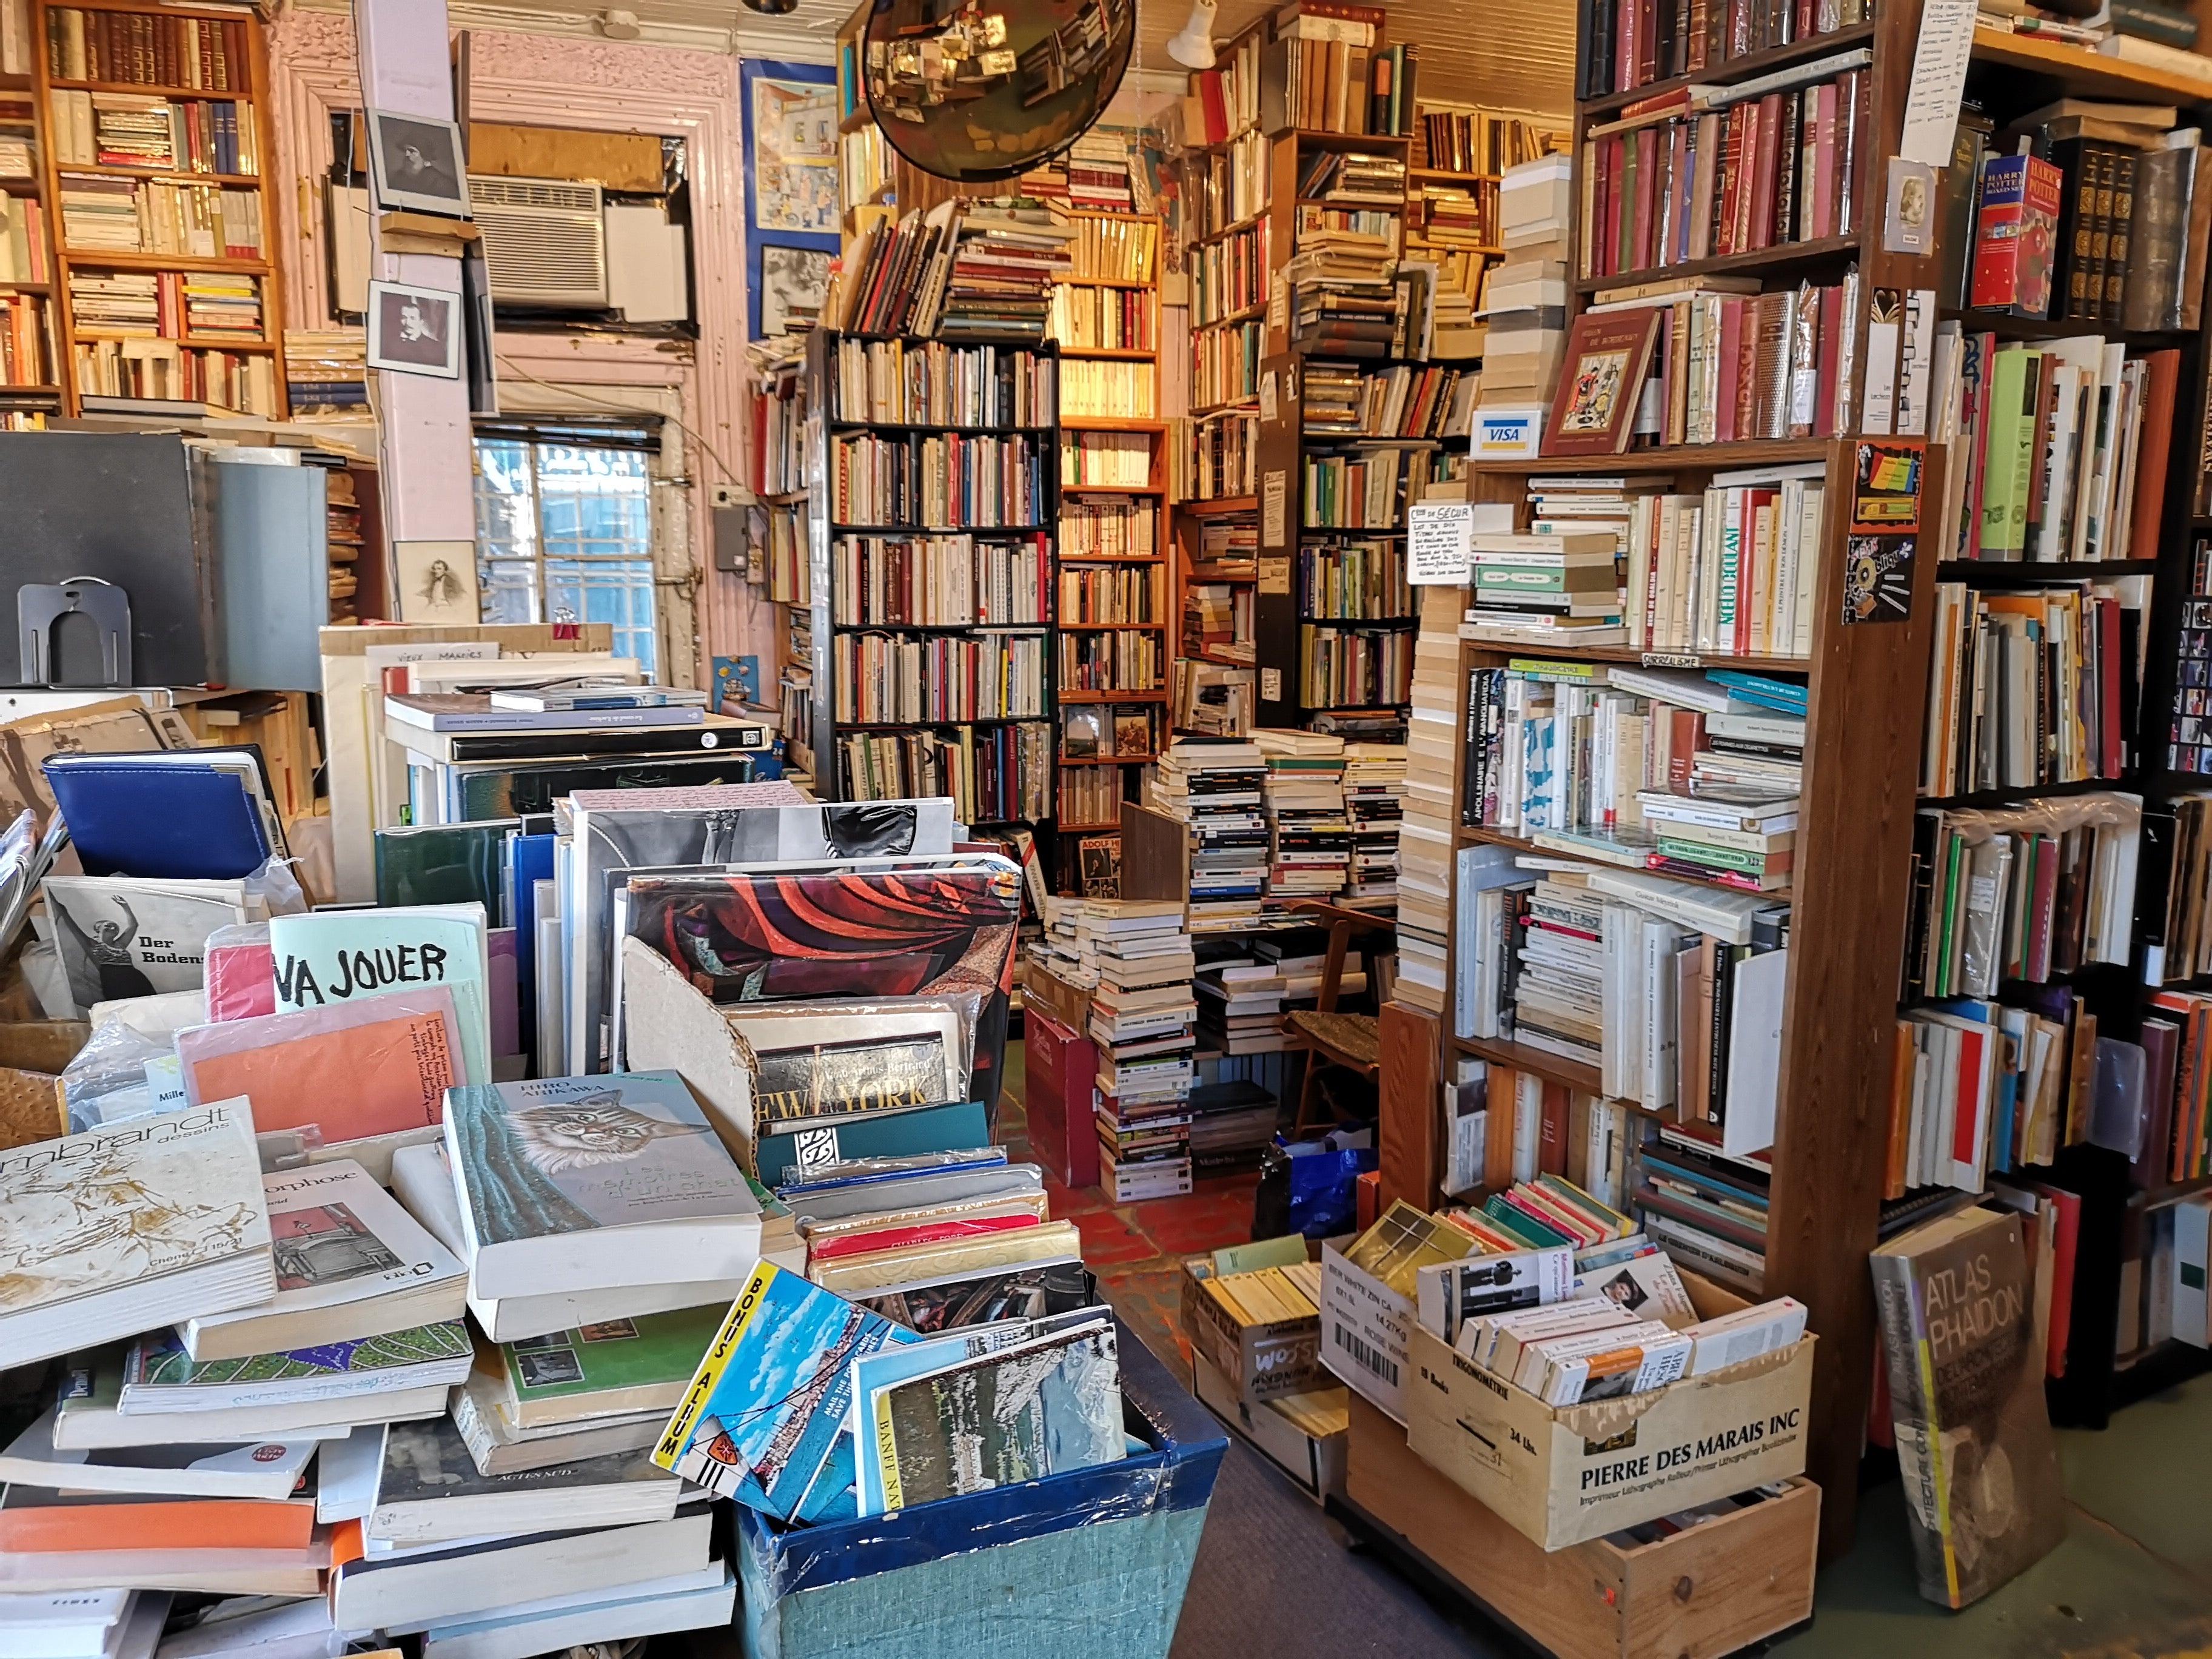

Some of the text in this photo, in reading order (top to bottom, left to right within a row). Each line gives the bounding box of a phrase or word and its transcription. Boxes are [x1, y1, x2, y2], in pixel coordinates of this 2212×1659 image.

[1987, 179, 2024, 189] POTTER
[1988, 171, 2022, 182] HARRY
[2031, 161, 2060, 184] HARRY
[2029, 178, 2058, 204] POTTER
[1489, 427, 1519, 443] VISA
[1479, 674, 1490, 746] L'AVANGUARDIA
[1474, 761, 1485, 819] APOLLINAIRE
[1082, 840, 1108, 848] ADOLF
[139, 935, 174, 949] Der
[271, 953, 326, 1008] VA
[329, 942, 447, 999] JOUER
[520, 1082, 570, 1091] HIRO
[522, 1085, 605, 1097] ARIKAWA
[757, 1075, 928, 1121] EW YORK
[0, 1107, 229, 1174] mbrandt
[157, 1121, 229, 1144] dessins
[265, 1171, 358, 1191] orphose
[1344, 1275, 1366, 1296] WHITE
[1368, 1289, 1380, 1305] ZIN
[1381, 1300, 1392, 1312] CA
[1926, 1253, 1991, 1318] ATLAS
[1929, 1282, 2023, 1361] PHAIDON
[660, 1278, 764, 1457] BONUS ALBUM
[1452, 1353, 1509, 1401] TRIGONOMETRIE
[823, 1395, 839, 1417] MAIL
[834, 1378, 847, 1395] THE
[830, 1399, 846, 1419] SAVE
[842, 1385, 852, 1399] THE
[879, 1419, 896, 1473] BANFF
[1510, 1427, 1521, 1444] 34
[1581, 1408, 1800, 1490] PIERRE DES MARAIS INC
[497, 1469, 572, 1481] ACTES SUD
[1580, 1489, 1621, 1506] Imprimeur
[1622, 1477, 1666, 1496] Lithographe
